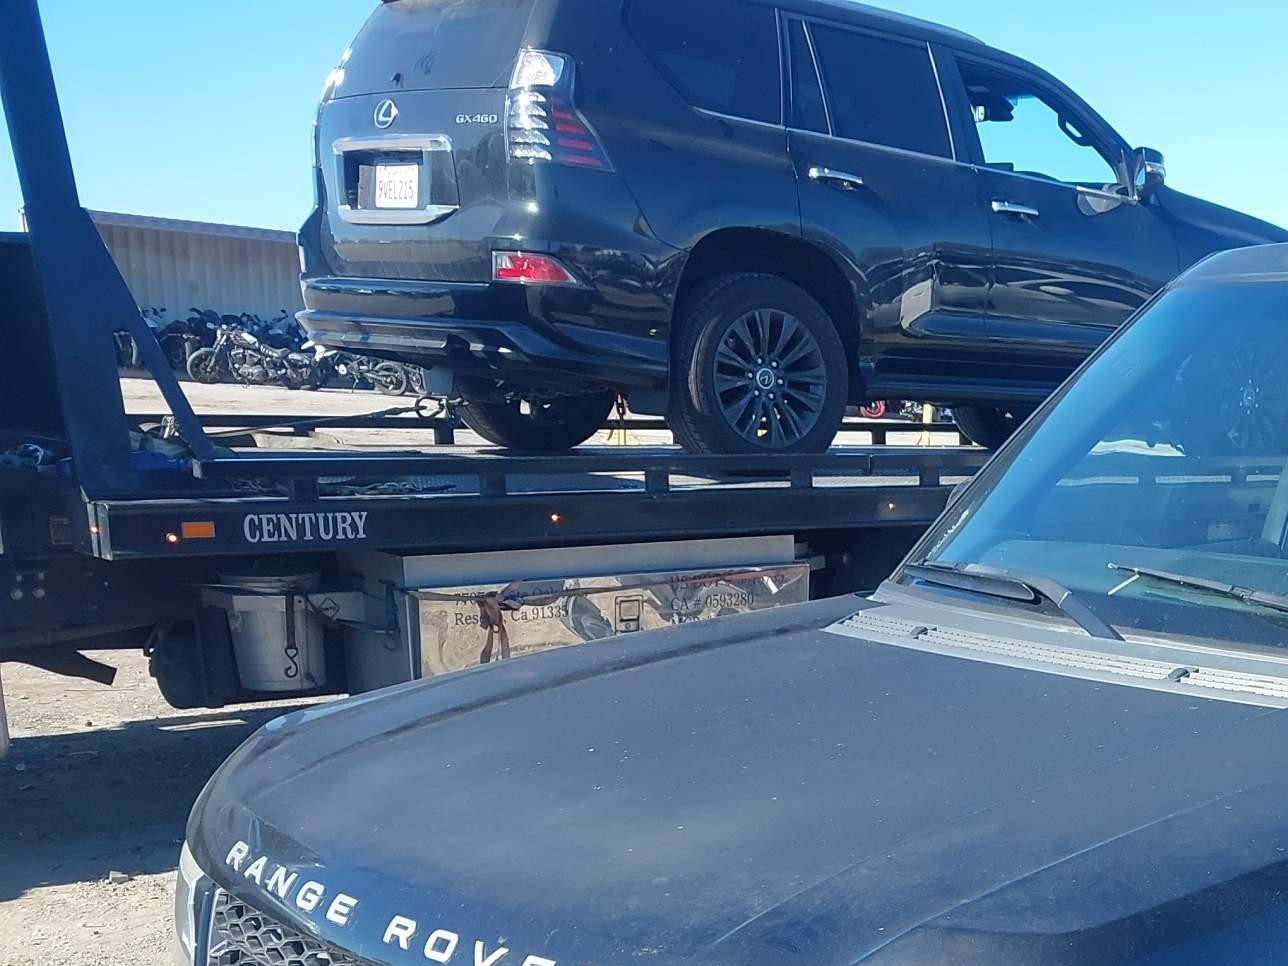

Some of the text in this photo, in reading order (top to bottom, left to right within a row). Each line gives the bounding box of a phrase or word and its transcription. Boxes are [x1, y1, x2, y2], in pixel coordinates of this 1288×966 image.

[378, 179, 415, 200] 9VEL215
[243, 511, 367, 543] CENTURY
[511, 605, 528, 621] Ca
[531, 601, 569, 620] 91335
[671, 591, 754, 610] CA # 0593280
[225, 840, 359, 927] RANGE
